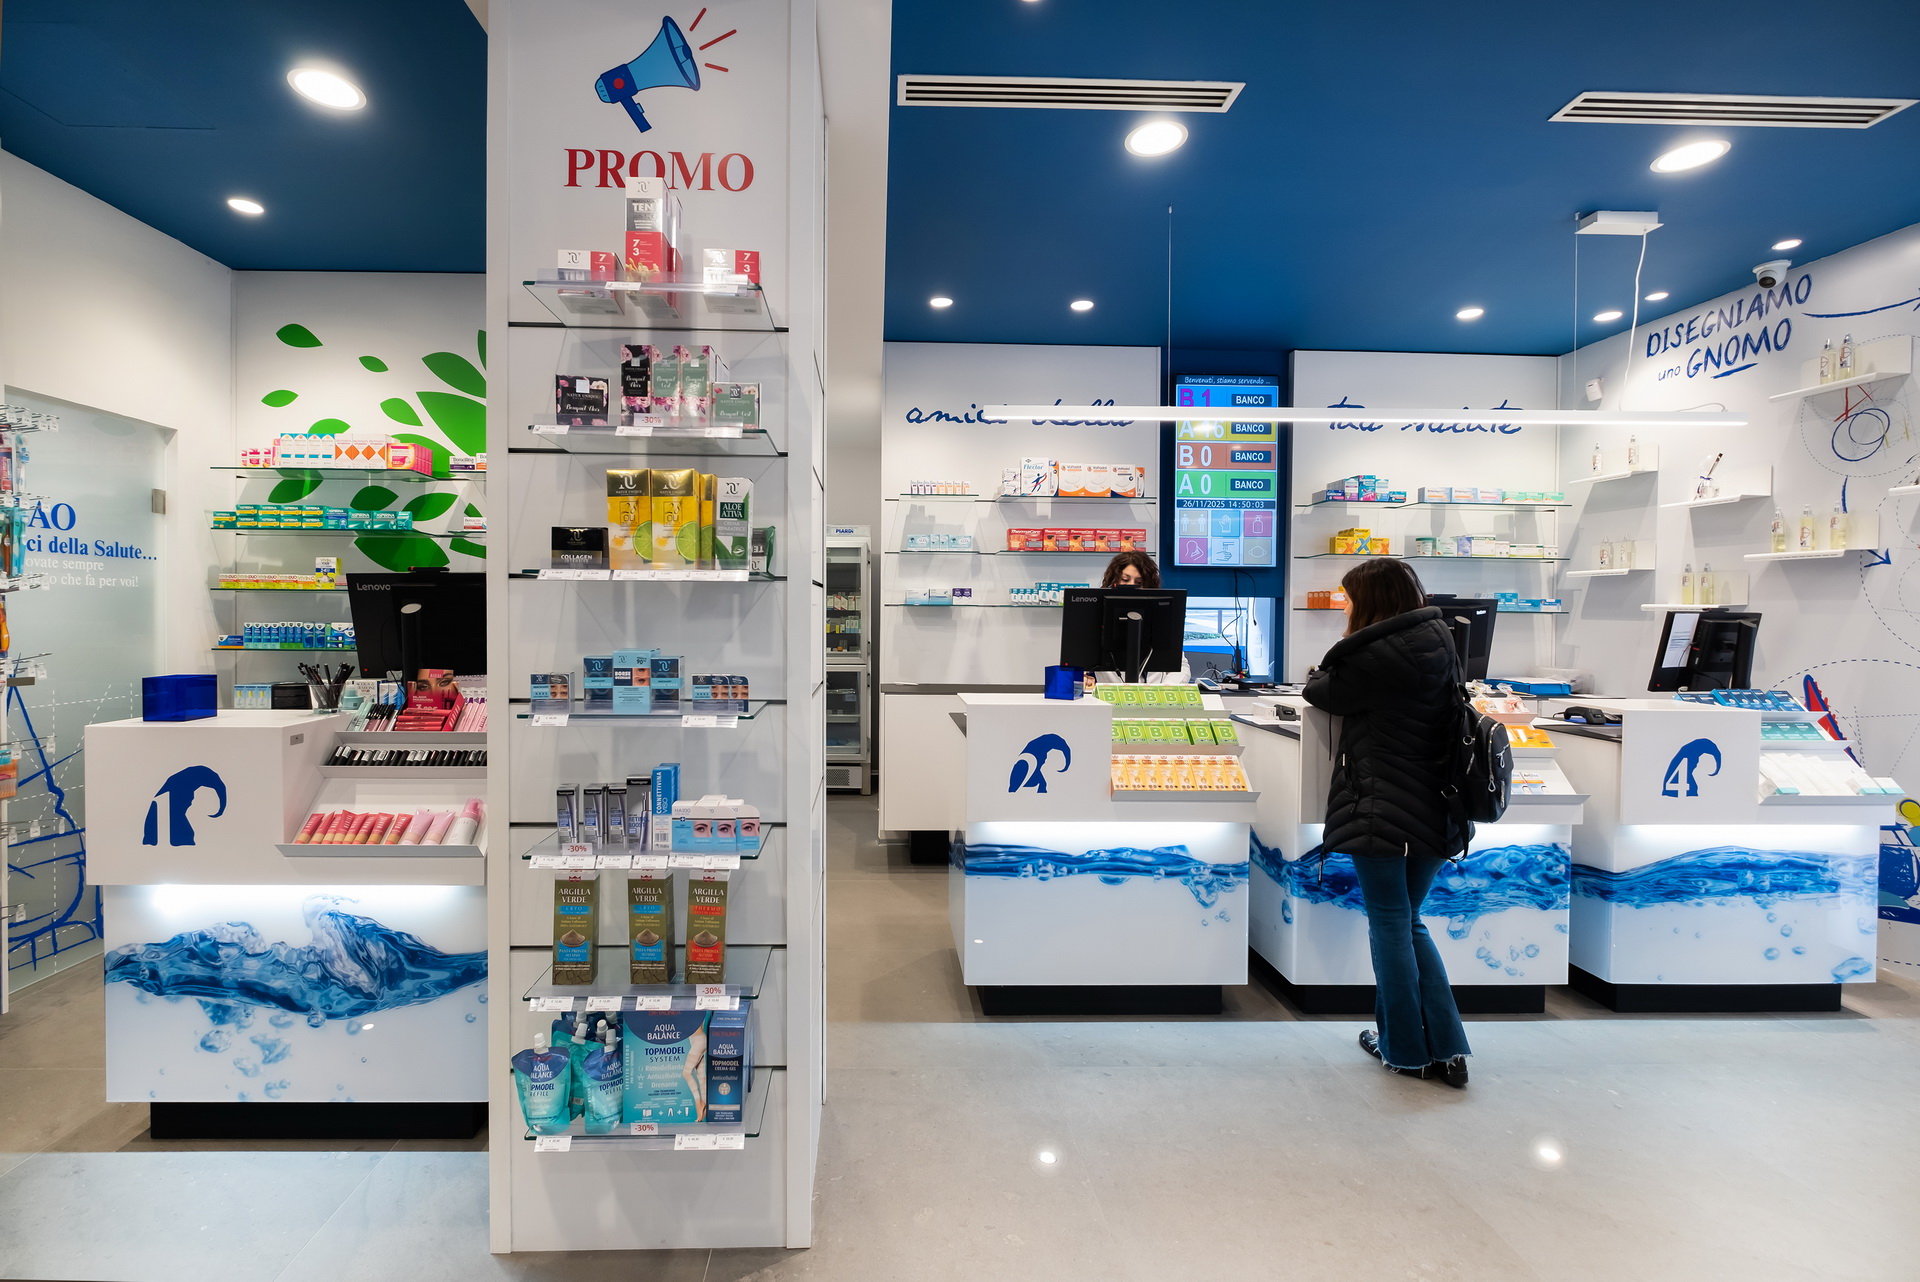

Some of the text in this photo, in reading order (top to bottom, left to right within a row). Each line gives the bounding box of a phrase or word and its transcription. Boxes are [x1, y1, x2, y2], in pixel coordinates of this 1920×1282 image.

[564, 148, 755, 192] PROMO
[1646, 273, 1812, 358] DISEGNIAMO
[1658, 317, 1792, 381] uno GNOMO
[1216, 377, 1236, 385] stiamo
[1180, 388, 1264, 407] B 1 BANCO
[641, 416, 661, 425] -30%
[1179, 420, 1195, 438] A
[1235, 424, 1264, 432] BANCO
[1180, 445, 1264, 467] B 0 BANCO
[1178, 473, 1264, 495] A 0 BANCO
[1183, 500, 1264, 508] 26/11/2025 14:50:03
[22, 498, 76, 531] AO
[721, 510, 743, 518] ATIVA
[26, 534, 157, 560] ci della Salute...
[25, 557, 104, 573] ovate sempre
[61, 573, 81, 586] che
[85, 573, 95, 586] fa
[99, 576, 116, 589] per
[120, 576, 139, 587] voi!
[356, 583, 391, 591] Lenovo
[1664, 756, 1690, 797] 4
[632, 887, 662, 895] ARGILLA
[692, 888, 724, 896] ARGILLA
[654, 1023, 676, 1033] AQUA
[647, 1032, 681, 1040] BALANCE
[645, 1047, 685, 1055] TOPMODEL
[533, 1063, 549, 1071] AQUA
[606, 1060, 622, 1071] AQUA
[601, 1068, 623, 1080] BALANC
